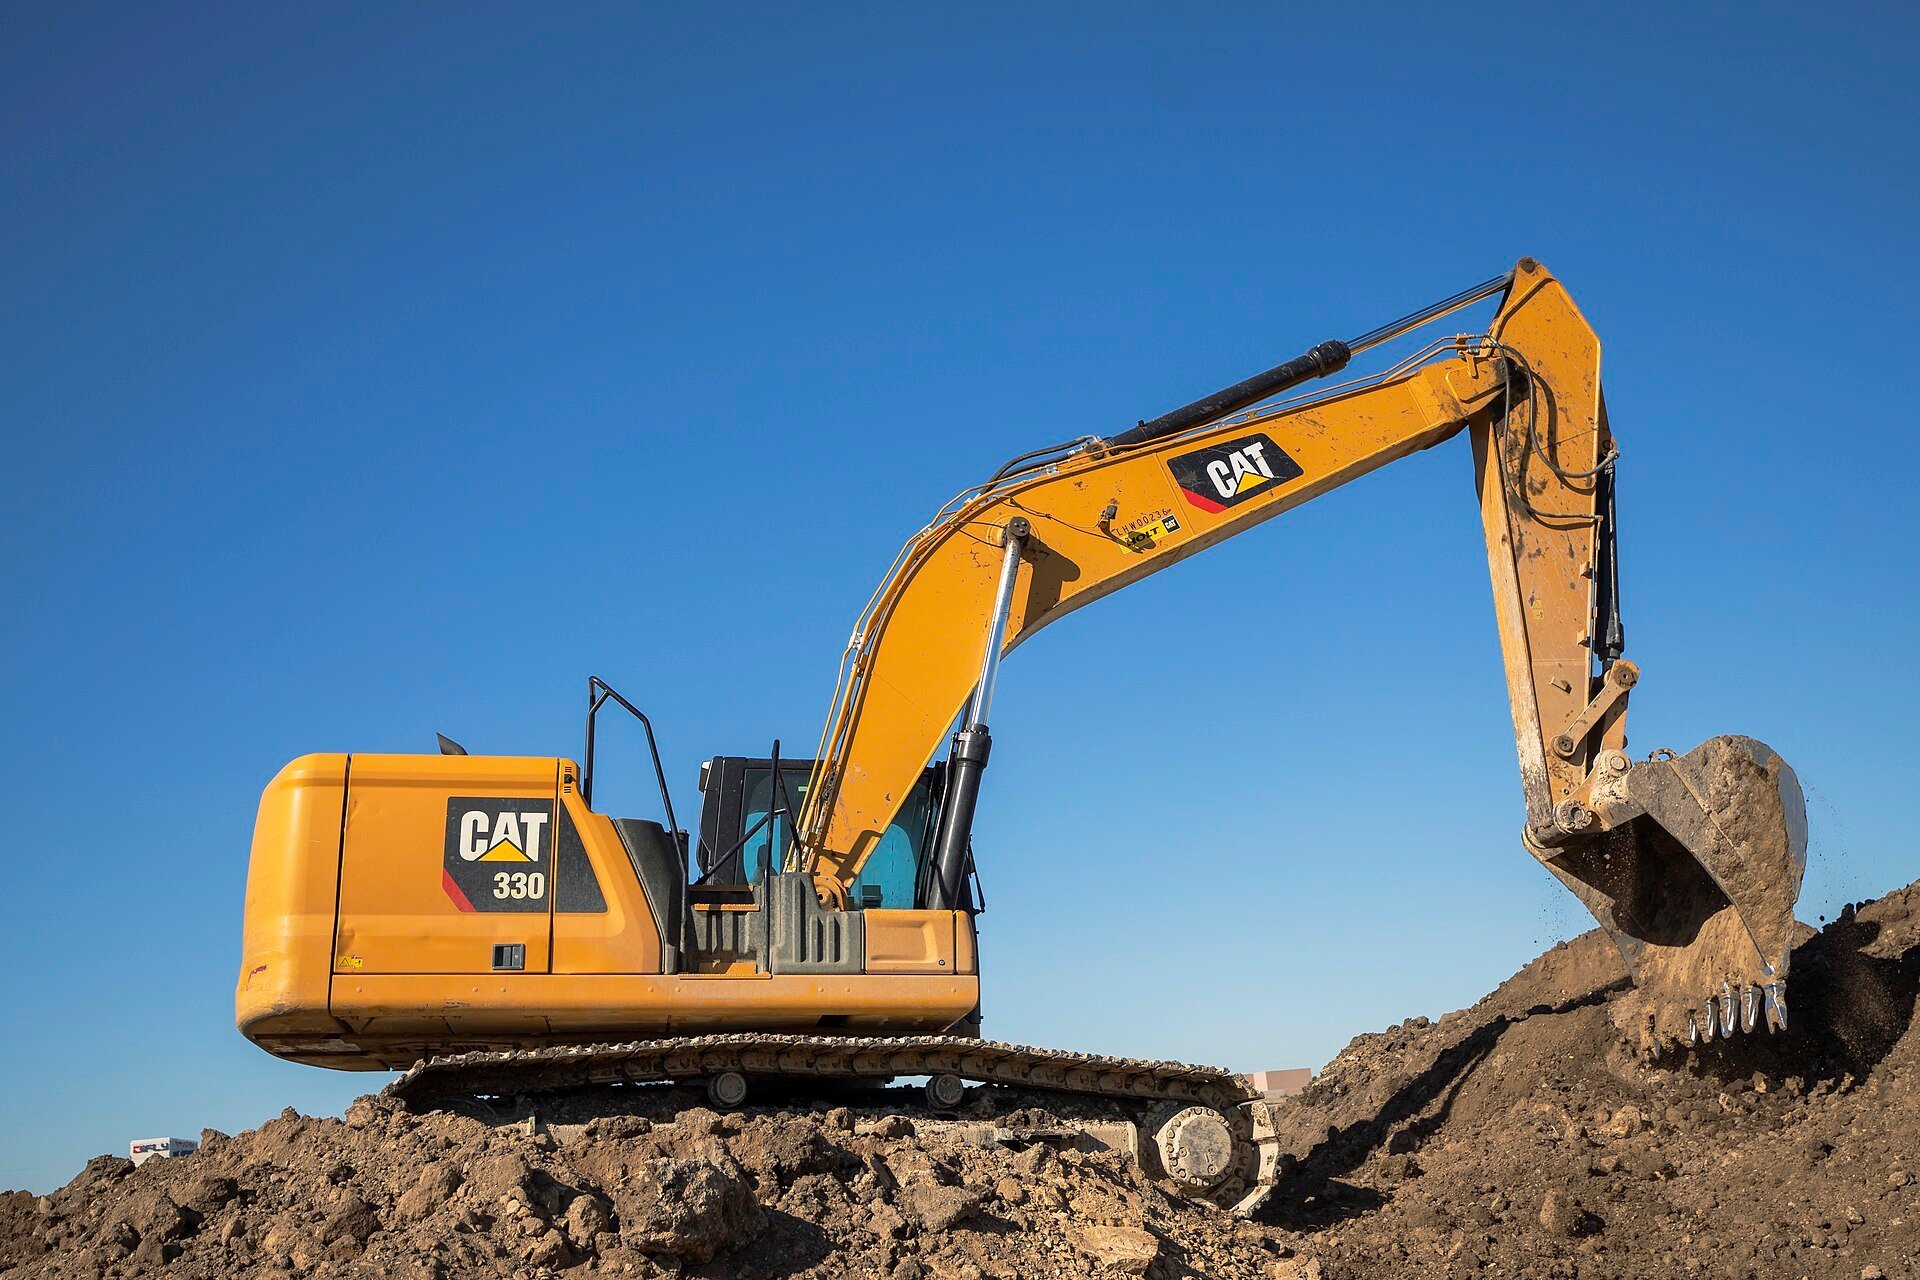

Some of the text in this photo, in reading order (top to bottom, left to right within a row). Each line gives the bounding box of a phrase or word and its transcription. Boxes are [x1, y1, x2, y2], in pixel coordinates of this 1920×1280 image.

[1206, 441, 1275, 498] CAT
[1164, 519, 1177, 530] CAT
[459, 810, 548, 862] CAT
[493, 872, 545, 899] 330
